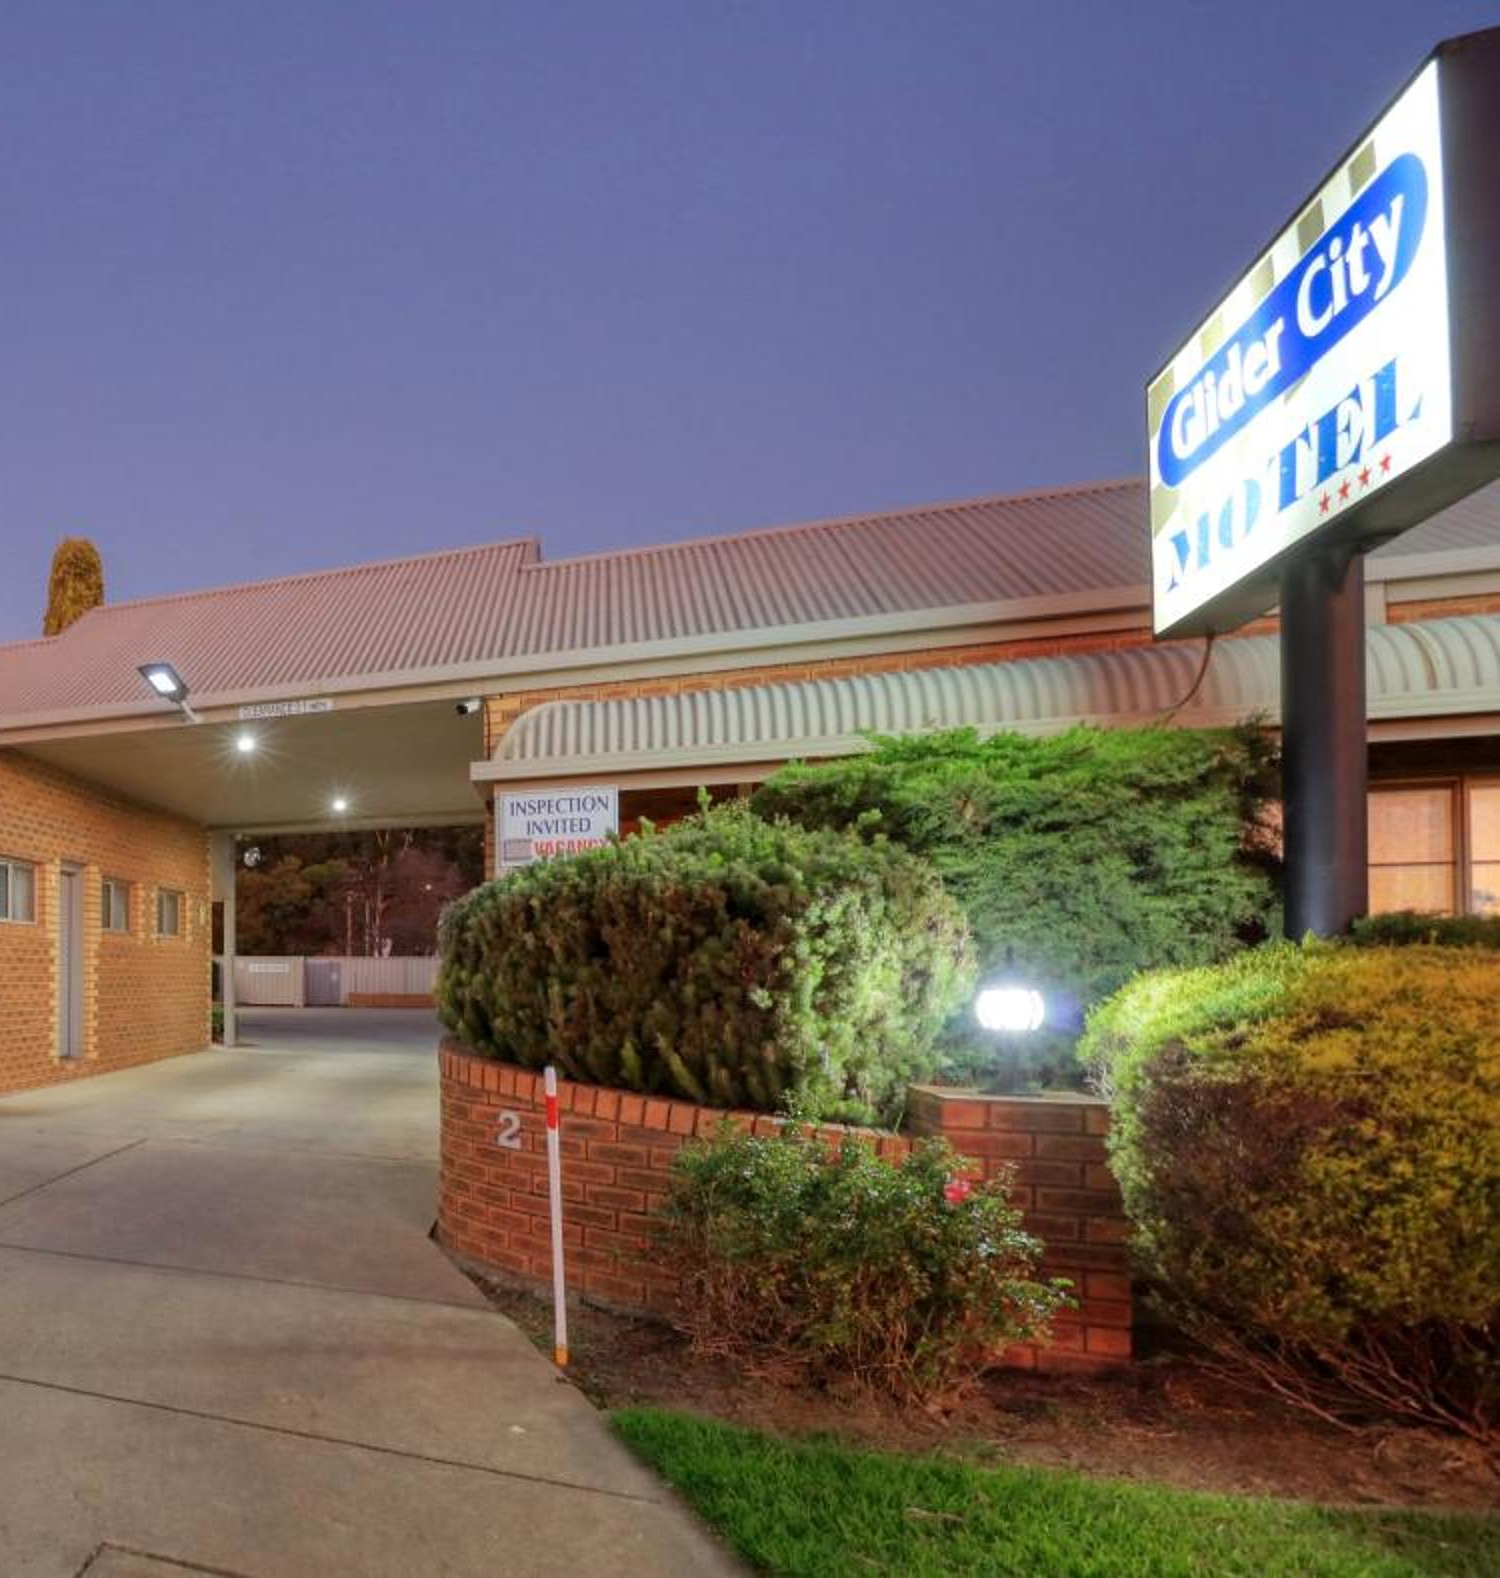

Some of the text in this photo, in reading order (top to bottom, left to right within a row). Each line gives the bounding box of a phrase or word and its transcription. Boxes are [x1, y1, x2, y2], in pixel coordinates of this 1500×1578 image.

[1169, 193, 1405, 461] Glider City
[1166, 355, 1424, 593] MOTEL
[509, 795, 609, 817] INSPECTION
[526, 817, 592, 836] INVITED
[497, 1109, 522, 1150] 2
